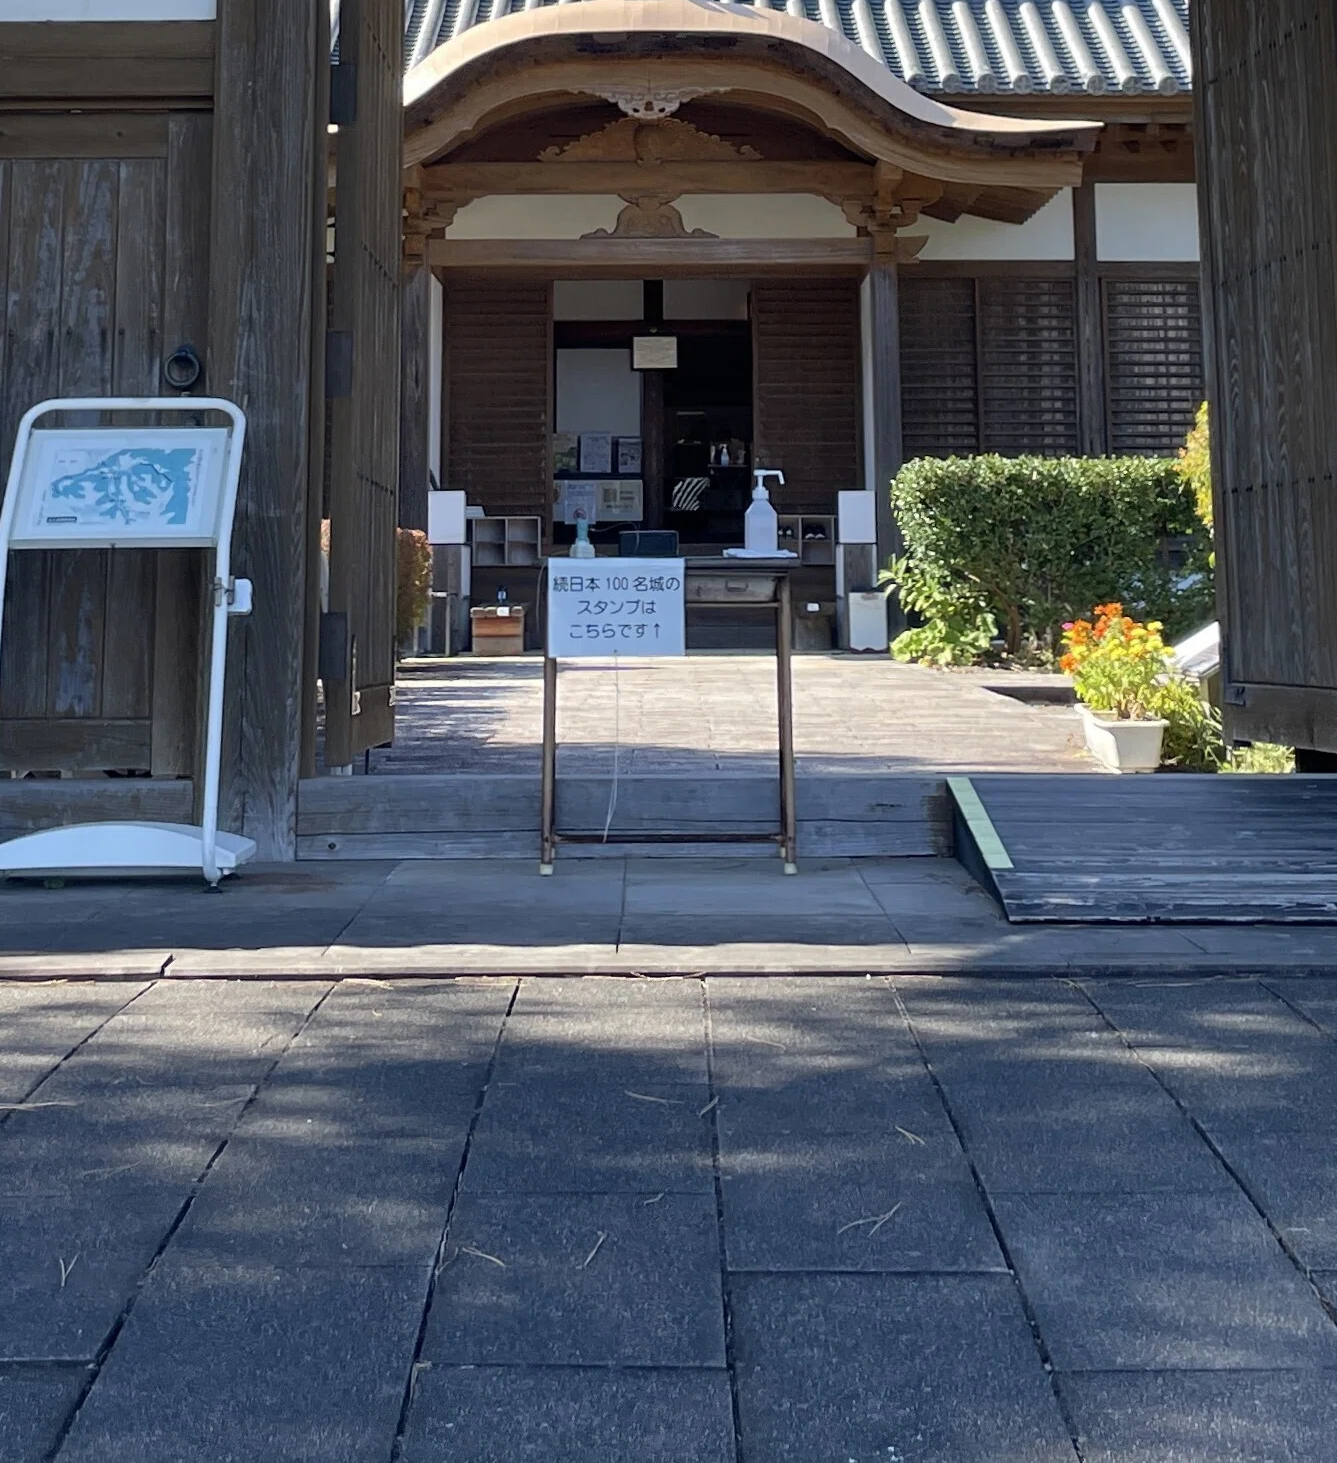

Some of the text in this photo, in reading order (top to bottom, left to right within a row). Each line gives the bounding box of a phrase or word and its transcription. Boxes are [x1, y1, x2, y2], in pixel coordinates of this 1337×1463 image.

[553, 576, 680, 592] 続日本100名城の
[577, 599, 656, 615] スタンプは
[569, 623, 648, 639] こちらです
